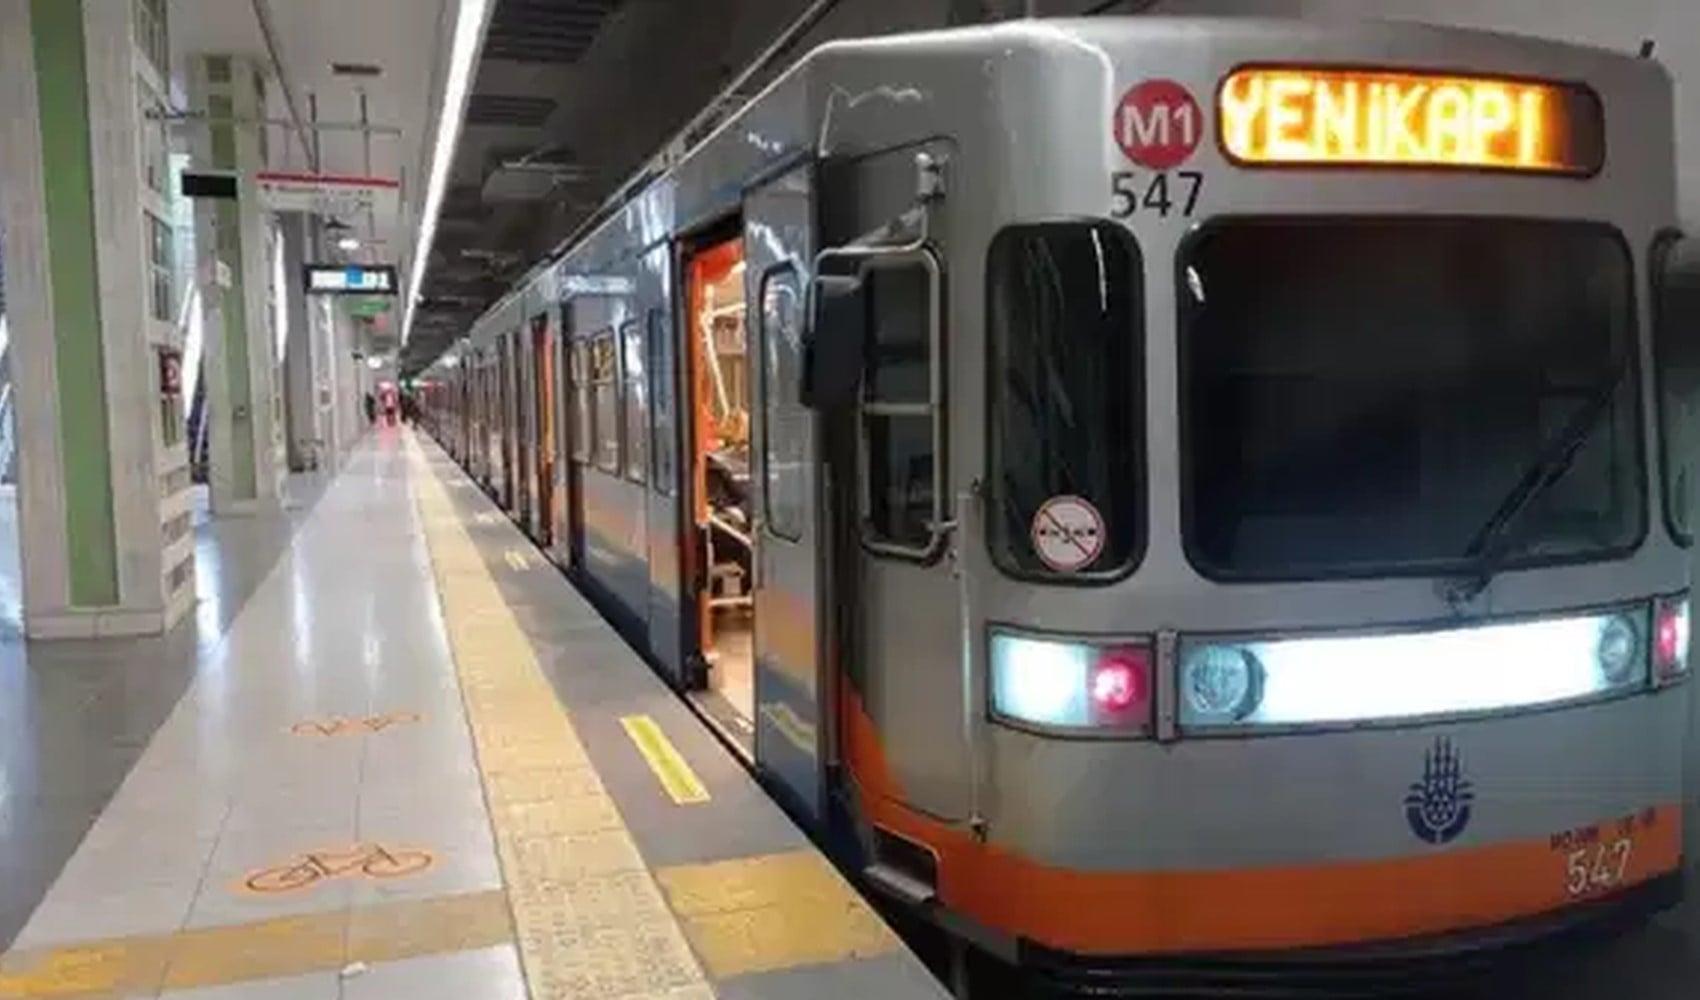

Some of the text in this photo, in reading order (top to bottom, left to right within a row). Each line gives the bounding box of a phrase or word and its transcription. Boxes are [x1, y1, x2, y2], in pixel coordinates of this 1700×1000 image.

[1123, 102, 1194, 147] M1
[1110, 171, 1204, 219] 547
[1567, 839, 1632, 894] 547
